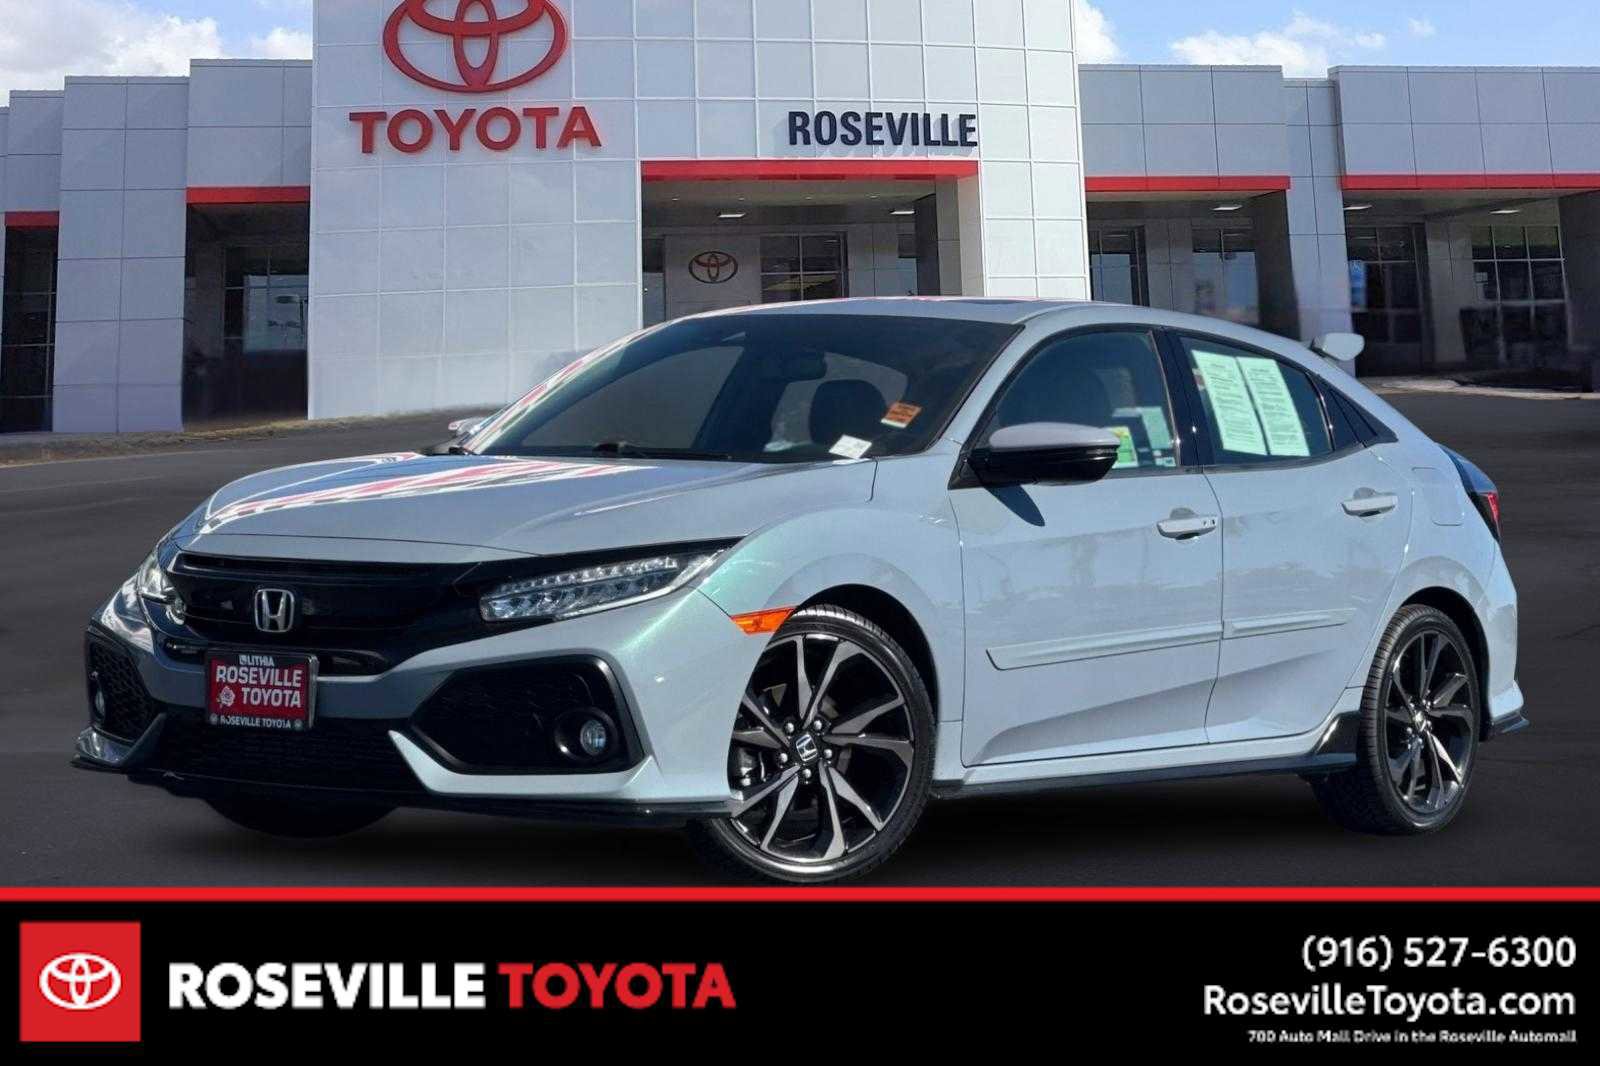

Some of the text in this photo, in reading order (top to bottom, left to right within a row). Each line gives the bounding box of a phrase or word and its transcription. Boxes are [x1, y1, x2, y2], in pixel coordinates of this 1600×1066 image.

[349, 106, 602, 154] TOYOTA
[788, 110, 979, 147] ROSEVILLE
[248, 656, 275, 667] LITHIA
[215, 665, 303, 688] ROSEVILLE
[241, 687, 302, 708] TOYOTA
[220, 715, 292, 729] ROSEVILLE TOYOTA
